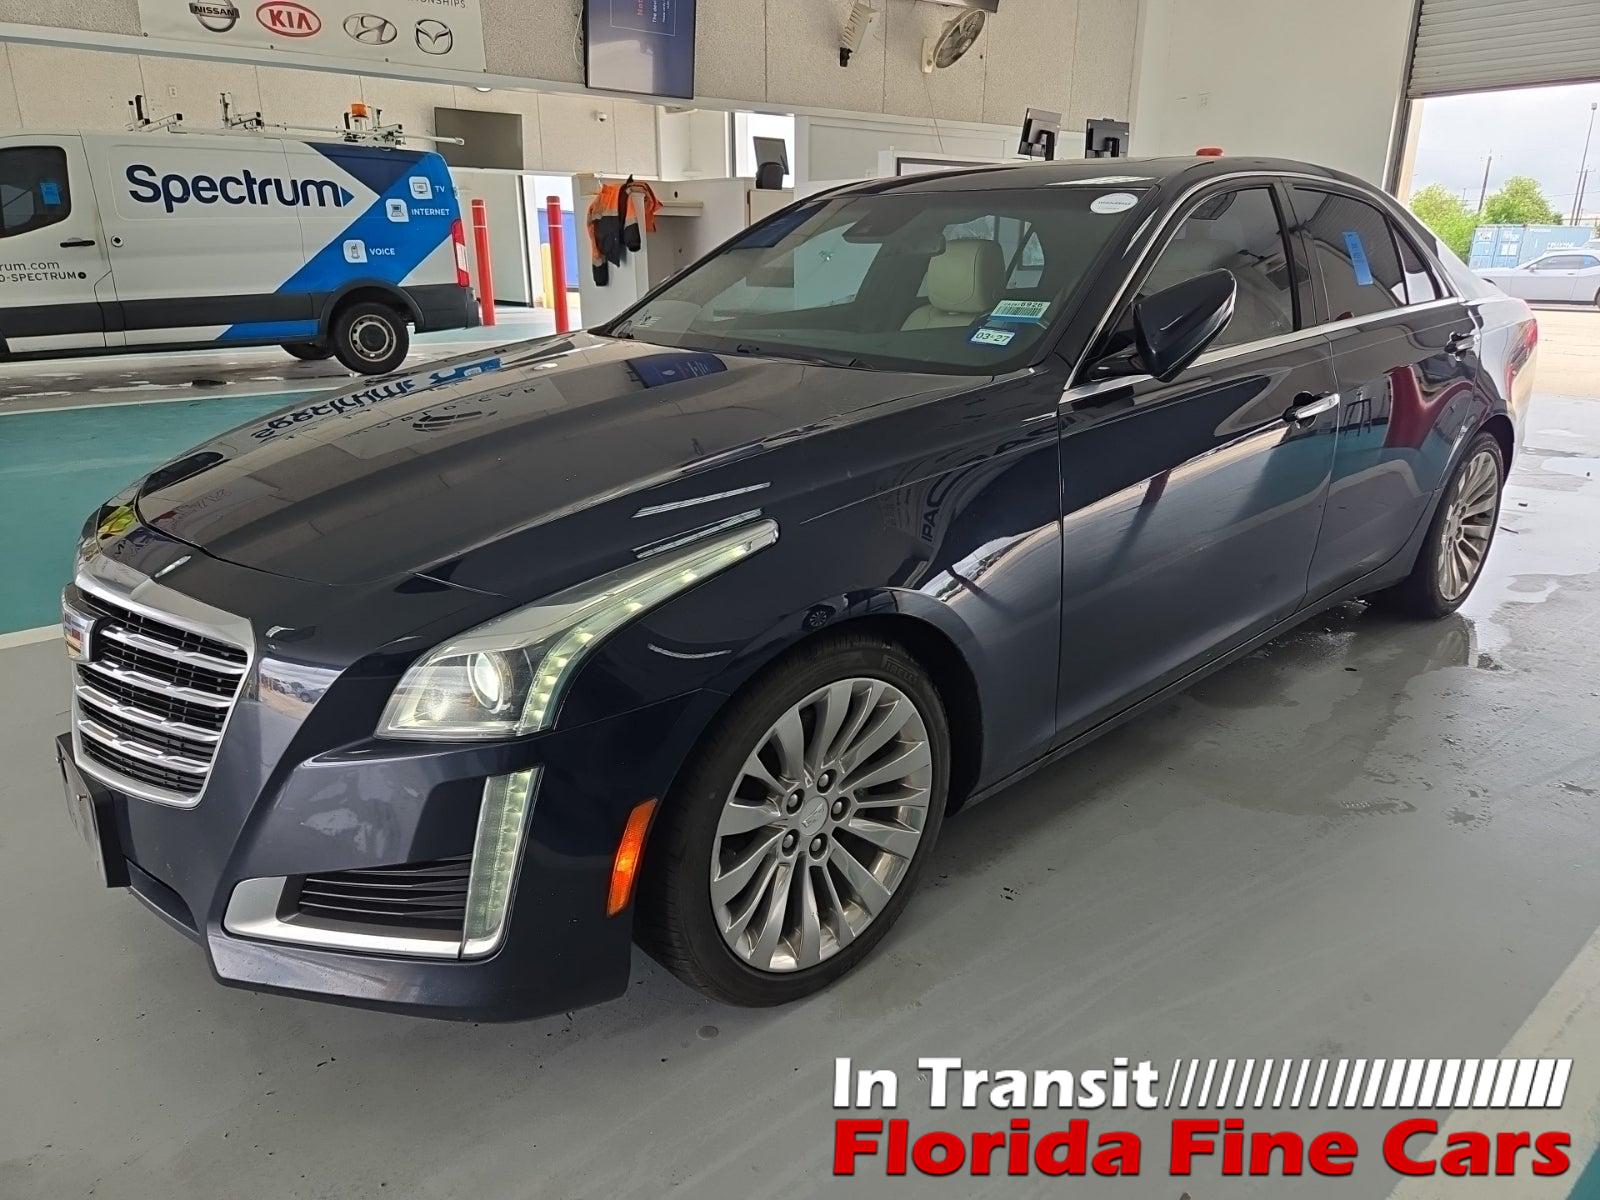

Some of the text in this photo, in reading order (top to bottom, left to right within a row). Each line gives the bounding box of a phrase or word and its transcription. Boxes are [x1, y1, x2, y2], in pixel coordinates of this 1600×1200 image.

[194, 5, 235, 16] NISSAN
[268, 9, 313, 31] KIA
[126, 164, 342, 212] Spectrum
[434, 185, 445, 193] TV
[411, 208, 450, 216] INTERNET
[369, 247, 396, 256] VOICE
